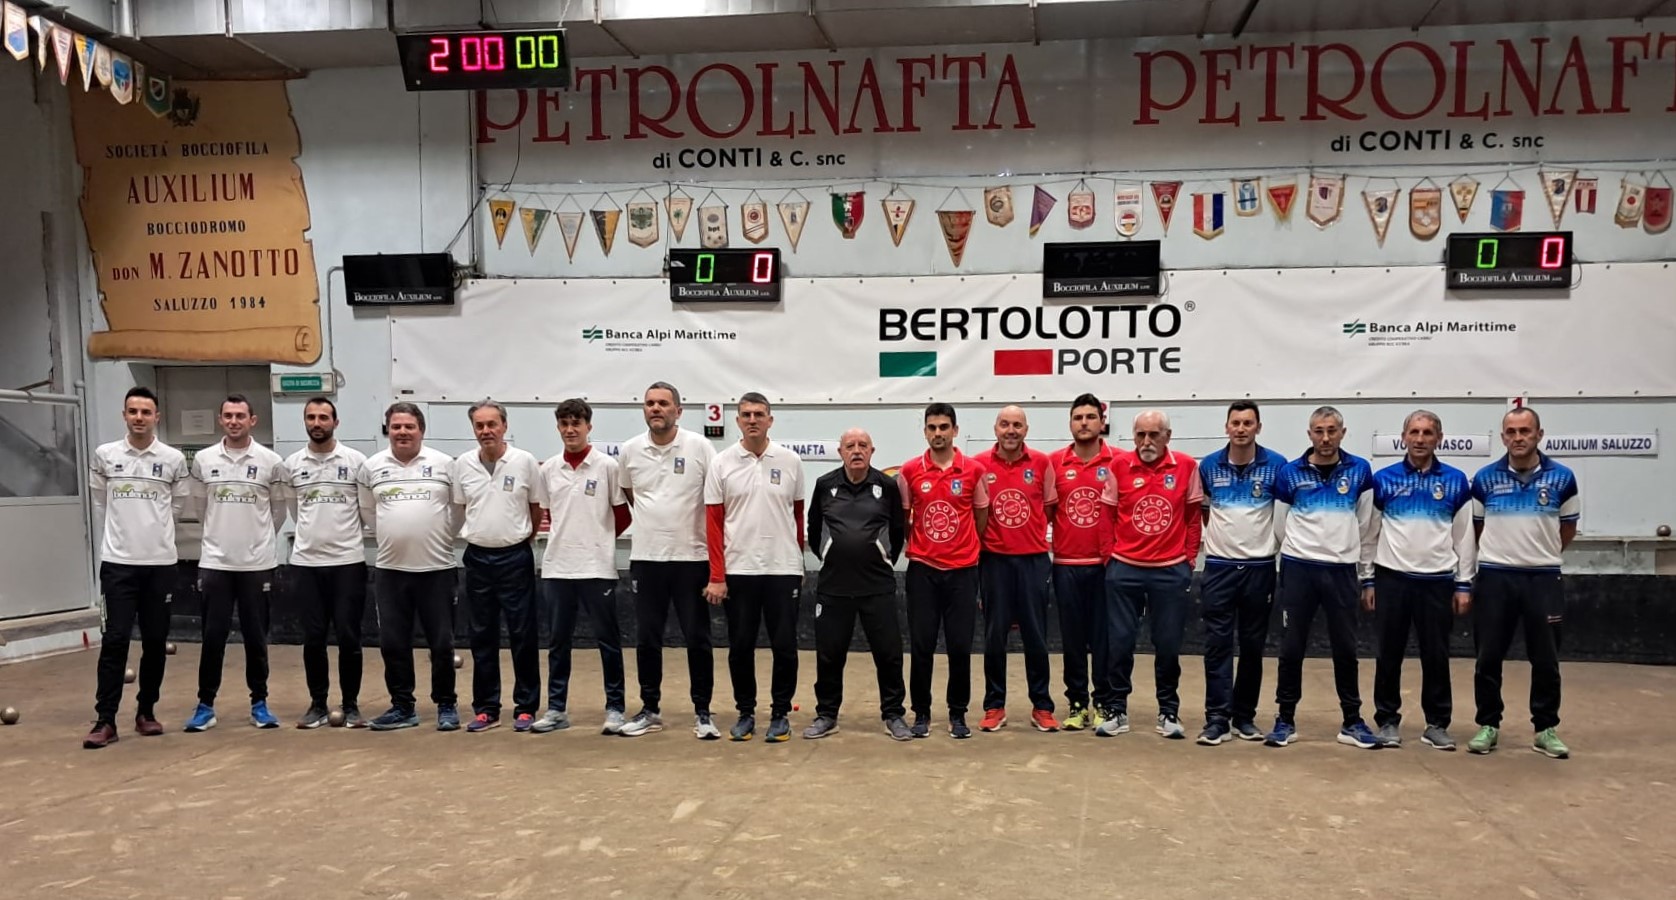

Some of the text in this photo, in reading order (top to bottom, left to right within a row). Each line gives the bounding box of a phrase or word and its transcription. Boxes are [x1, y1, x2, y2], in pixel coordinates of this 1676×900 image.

[429, 35, 559, 72] 2 00 00
[476, 53, 1036, 146] PETROLNAFTA
[1330, 129, 1545, 151] di CONTI & C. snc
[181, 142, 269, 157] BOCCIOFILA
[652, 147, 846, 169] di CONTI & C. snc
[127, 172, 255, 204] AUXILIUM
[147, 220, 246, 236] BOCCIODROMO
[112, 248, 299, 280] DON M. ZANOTTO
[1459, 272, 1507, 283] BOCCIOFILA
[1509, 271, 1551, 283] AUXILIUM
[678, 286, 721, 297] BOCCIOFILA
[722, 286, 759, 297] AUXILIUM
[1053, 282, 1098, 293] BOCCIOFILA
[1100, 280, 1138, 292] AUXILIUM
[153, 296, 267, 312] SALUZZO 1984
[397, 291, 432, 301] AUXILIUM
[879, 303, 1182, 341] BERTOLOTTO
[1369, 321, 1517, 334] Banca Alpi Marittime
[605, 329, 737, 342] Banca Alpi Marittime
[1057, 347, 1181, 375] PORTE
[708, 404, 722, 422] 3
[1545, 438, 1652, 450] AUXILIUM SALUZZO
